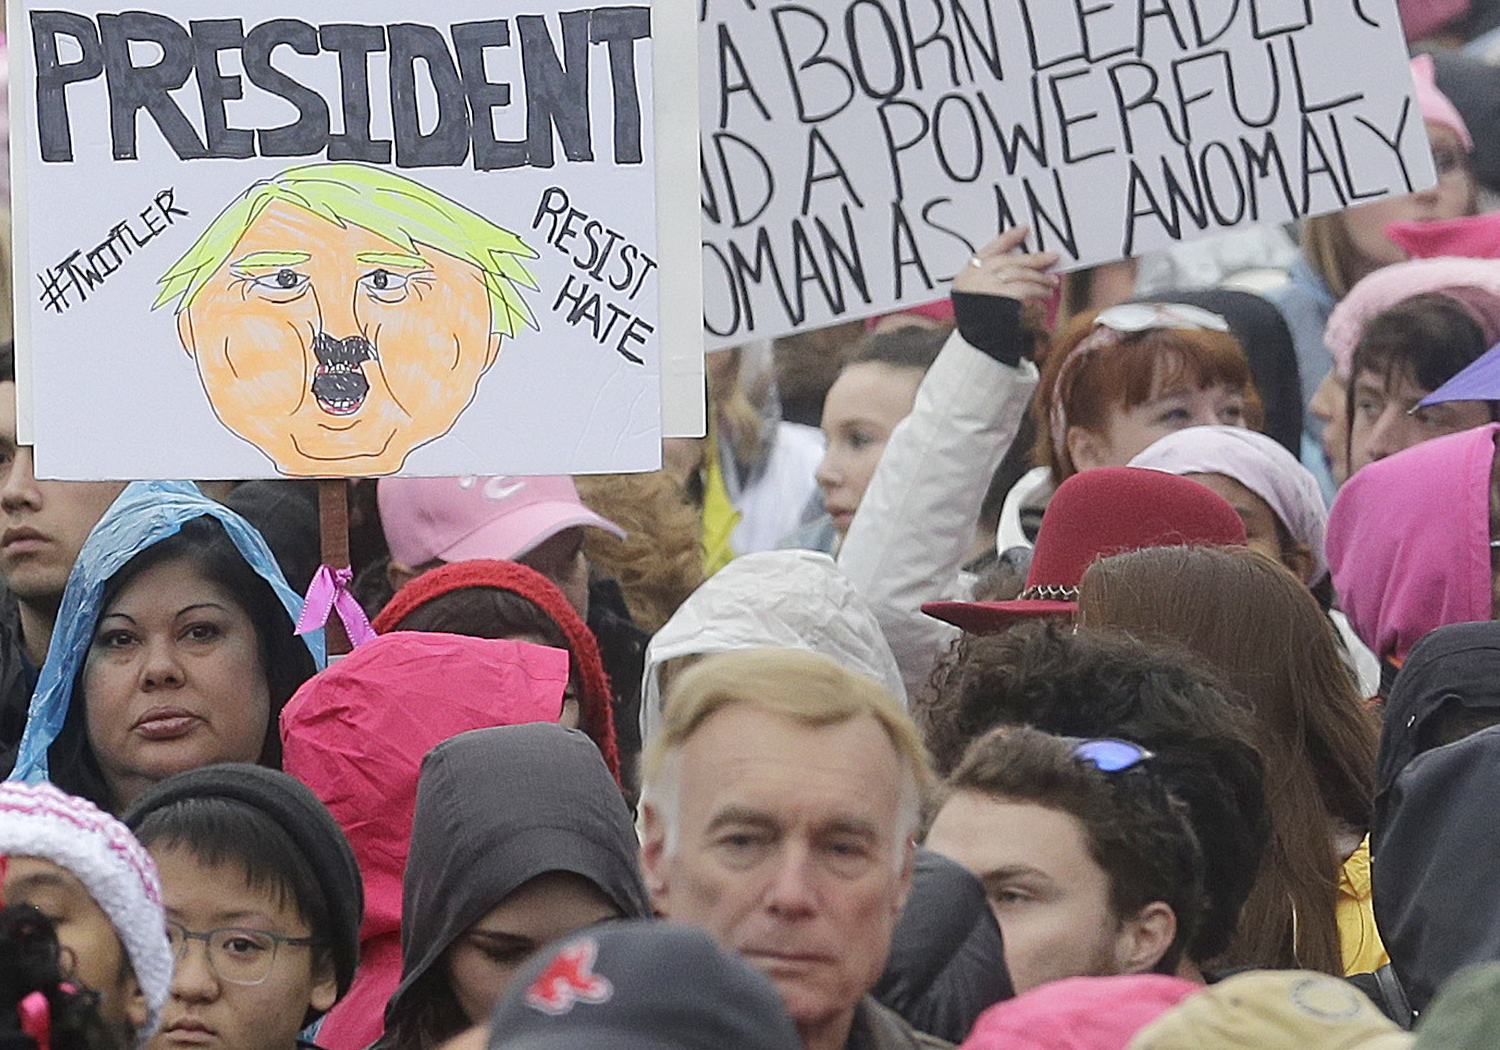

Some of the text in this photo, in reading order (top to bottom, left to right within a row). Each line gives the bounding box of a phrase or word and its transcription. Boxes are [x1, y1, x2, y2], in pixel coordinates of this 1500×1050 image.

[29, 6, 651, 171] PRESIDENT
[717, 23, 771, 128] A
[802, 126, 864, 216] A
[877, 36, 1364, 200] POWERFUL
[531, 186, 658, 300] RESIST
[1123, 97, 1413, 258] ANOMALY
[551, 275, 655, 366] HATE
